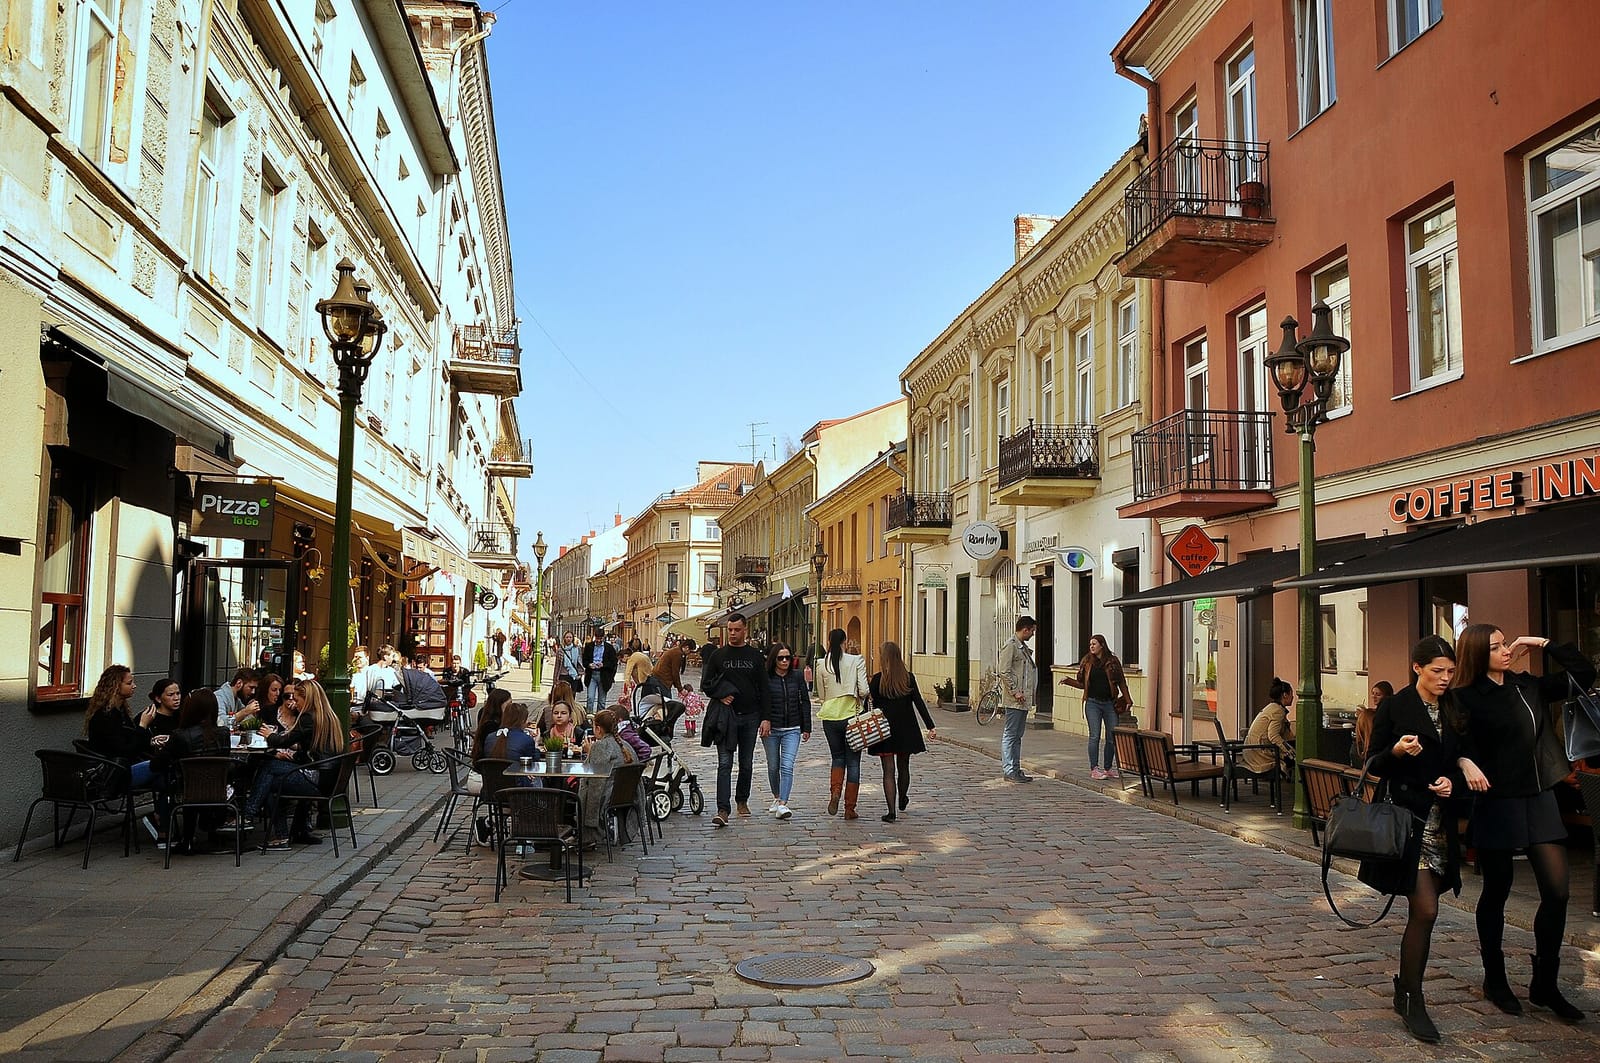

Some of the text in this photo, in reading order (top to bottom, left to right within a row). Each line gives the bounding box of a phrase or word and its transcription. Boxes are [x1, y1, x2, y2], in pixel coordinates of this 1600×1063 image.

[1388, 454, 1600, 524] COFFEE INN
[201, 494, 260, 516] Pizza
[232, 516, 259, 526] To Go
[1181, 554, 1209, 562] coffee
[1188, 561, 1201, 570] inn
[722, 659, 754, 669] GUESS
